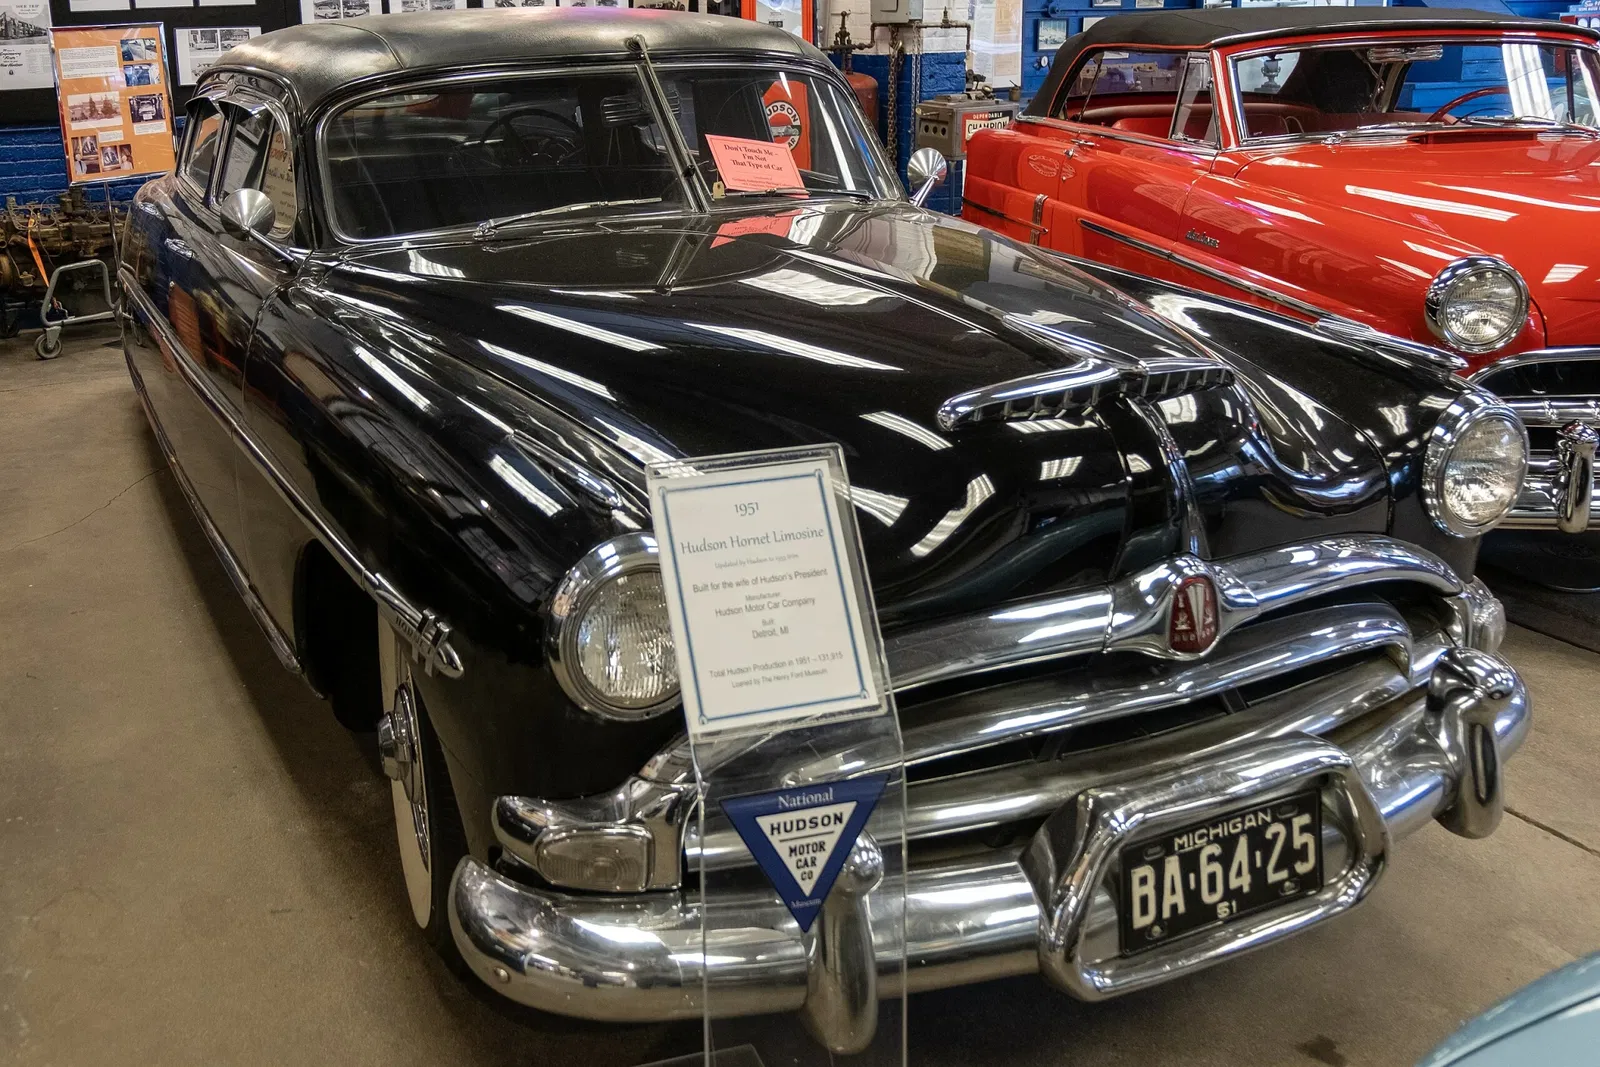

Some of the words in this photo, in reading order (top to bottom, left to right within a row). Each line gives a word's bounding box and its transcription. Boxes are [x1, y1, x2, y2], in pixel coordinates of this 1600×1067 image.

[767, 104, 798, 122] UDSON
[724, 144, 742, 152] Don't
[742, 146, 762, 154] Touch
[748, 160, 763, 169] Type
[734, 502, 760, 516] 1951
[680, 538, 728, 554] Hudson
[730, 532, 770, 548] Hornet
[773, 527, 824, 543] Limosine
[693, 582, 710, 592] Built
[710, 581, 720, 590] for
[722, 580, 734, 589] the
[735, 578, 750, 588] wife
[751, 577, 759, 586] of
[760, 572, 793, 584] Hudson's
[794, 568, 828, 580] President
[715, 607, 743, 617] Hudson
[744, 604, 766, 613] Motor
[768, 601, 780, 610] Car
[782, 596, 816, 608] Company
[780, 626, 789, 635] MI
[709, 670, 726, 678] Total
[726, 666, 752, 676] Hudson
[752, 662, 787, 672] Production
[796, 656, 810, 665] 1951
[732, 680, 752, 688] Loaned
[774, 672, 790, 682] Henry
[804, 668, 828, 677] Museum
[778, 788, 834, 810] National
[770, 812, 844, 836] HUDSON
[1174, 808, 1272, 852] MICHIGAN
[788, 840, 826, 857] MOTOR
[796, 857, 817, 870] CAR
[800, 871, 814, 880] CO
[790, 897, 822, 909] Museum
